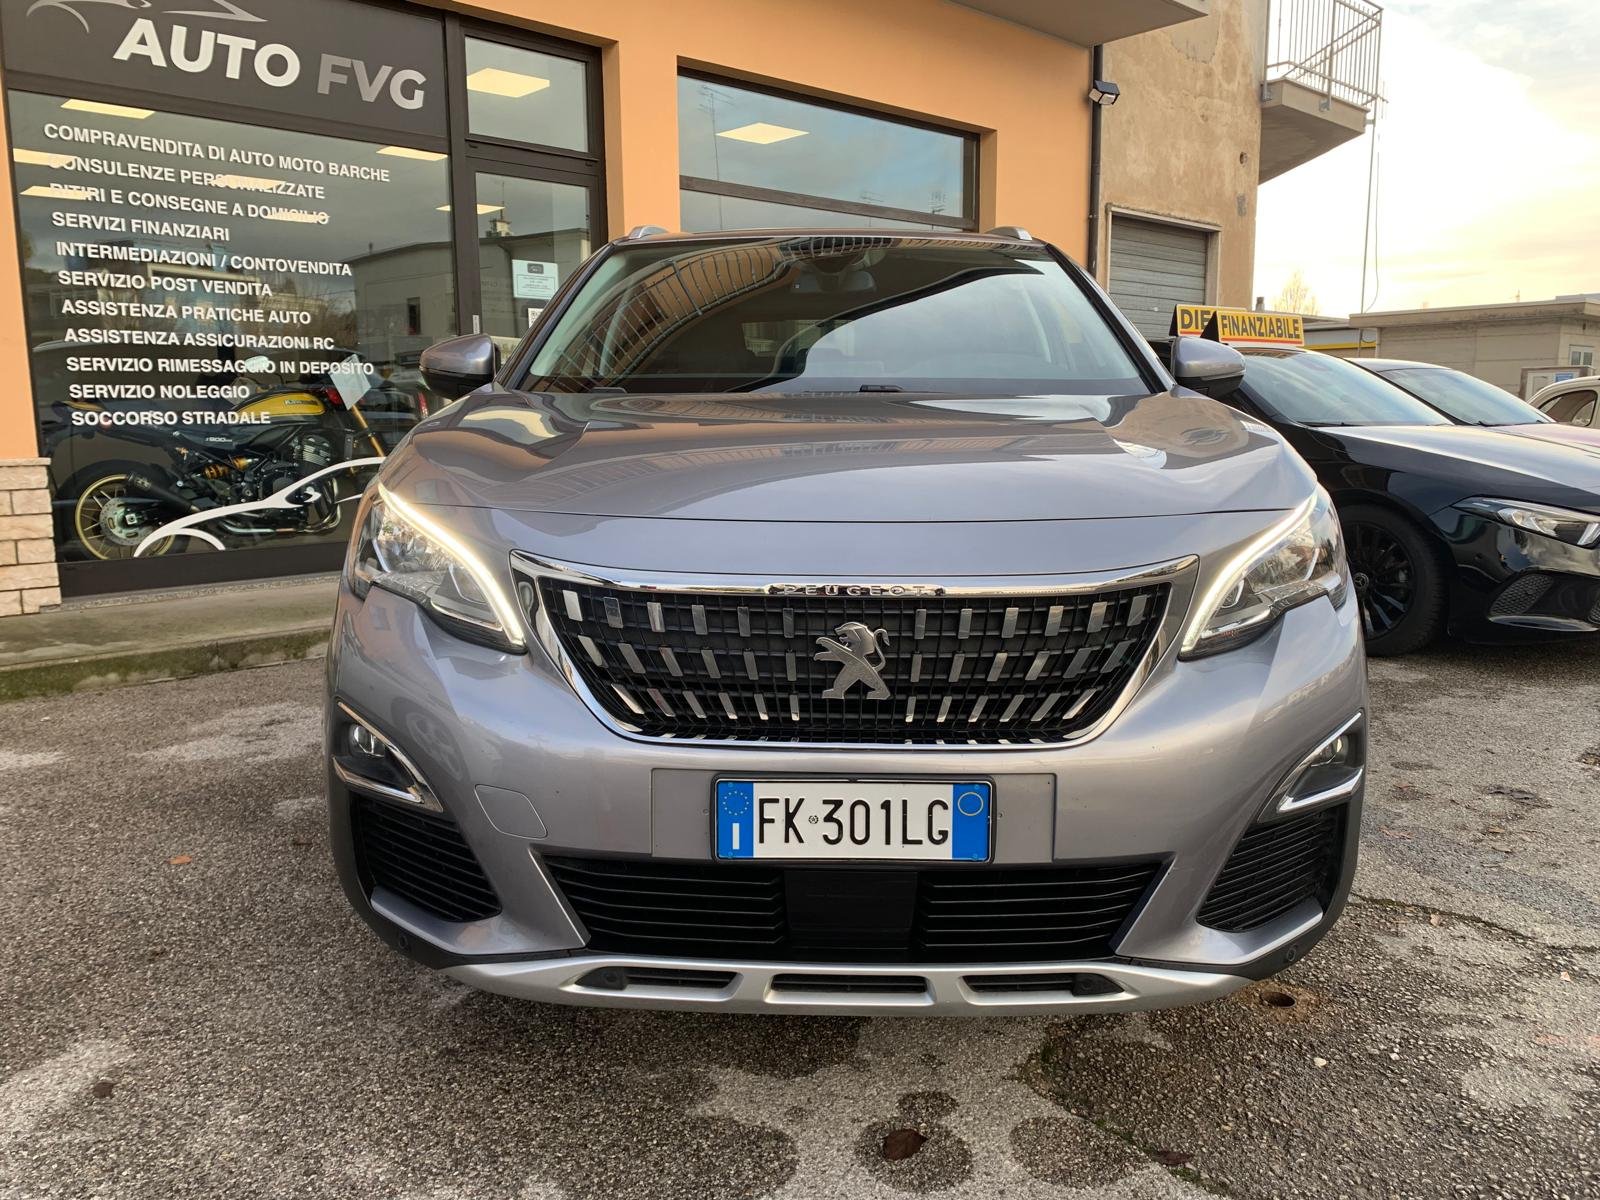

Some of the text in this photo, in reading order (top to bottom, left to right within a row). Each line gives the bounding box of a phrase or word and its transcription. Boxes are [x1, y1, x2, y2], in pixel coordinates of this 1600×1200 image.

[113, 17, 427, 111] AUTO FVG
[43, 123, 391, 182] COMPRAVENDITA DI AUTO MOTO BARCHE
[111, 189, 123, 204] E
[128, 192, 228, 215] CONSEGNE
[232, 202, 244, 217] A
[52, 211, 230, 241] SERVIZI FINANZIARI
[56, 241, 217, 267] INTERMEDIAZIONI
[230, 255, 352, 277] CONTOVENDITA
[58, 270, 273, 297] SERVIZIO POST VENDITA
[61, 299, 312, 325] ASSISTENZA PRATICHE AUTO
[64, 328, 335, 350] ASSISTENZA ASSICURAZIONI RC
[1220, 314, 1301, 340] FINANZIABILE
[66, 356, 153, 372] SERVIZIO
[280, 361, 296, 374] IN
[300, 361, 374, 375] DEPOSITO
[69, 384, 250, 399] SERVIZIO NOLEGGIO
[71, 411, 271, 426] SOCCORSO STRADALE
[784, 584, 926, 597] PEUGEOT
[758, 797, 805, 844] FK
[822, 799, 949, 846] 301LG
